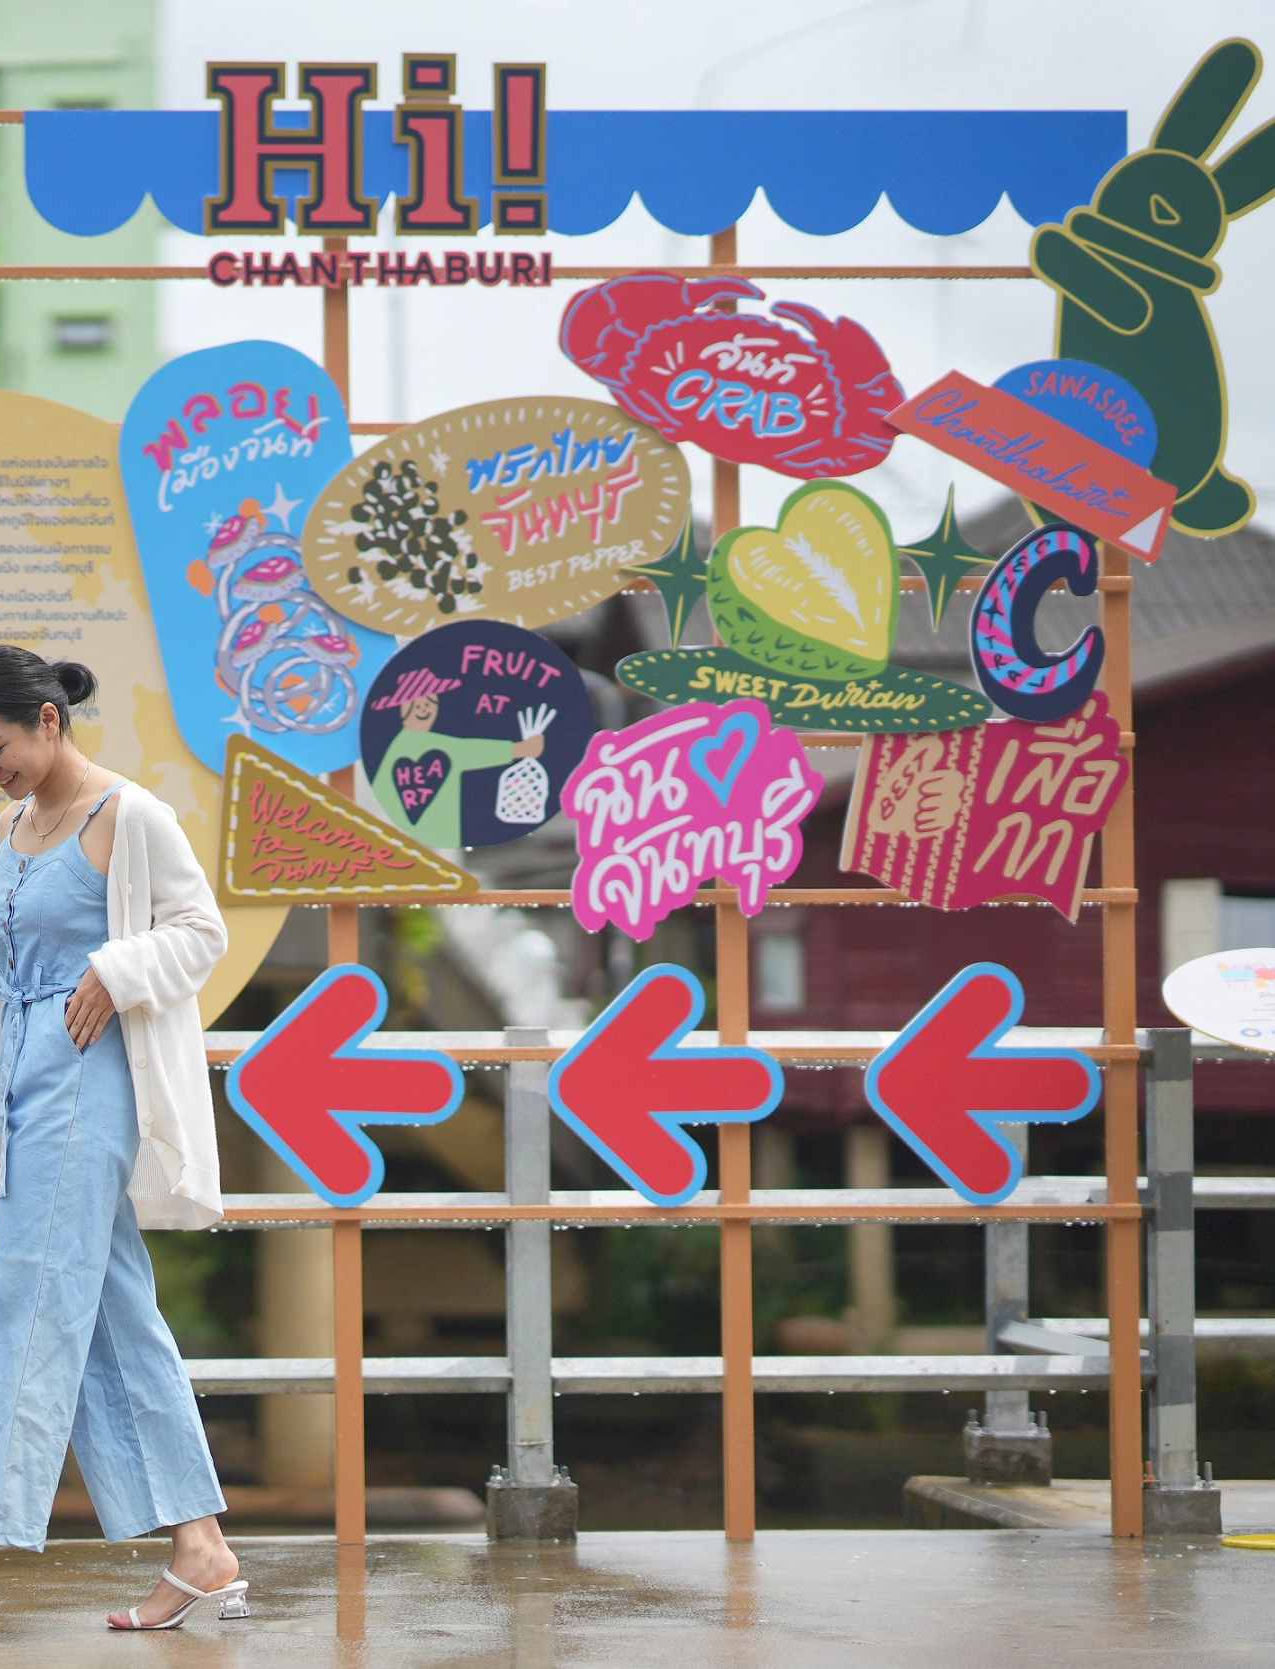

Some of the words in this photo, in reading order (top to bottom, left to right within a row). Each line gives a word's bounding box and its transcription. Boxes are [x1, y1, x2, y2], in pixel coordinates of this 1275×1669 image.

[204, 53, 546, 236] Hi!
[208, 250, 552, 287] CHANTHABURI
[700, 334, 817, 384] จันท์
[143, 382, 321, 471] พลอย
[666, 369, 807, 438] CRAB
[1025, 371, 1145, 445] SAWASDEE
[158, 417, 330, 512] เมืองจันท์
[465, 428, 637, 494] พริกไทย
[480, 453, 644, 556] จันทบุรี
[506, 559, 563, 592] BEST
[567, 538, 648, 579] PEPPER
[460, 645, 562, 689] FRUIT
[688, 666, 790, 702] SWEET
[784, 679, 925, 711] Durian
[475, 694, 511, 715] AT
[574, 716, 709, 848] ฉัน
[879, 751, 933, 822] BEST
[248, 780, 416, 871] Welcome
[250, 828, 306, 858] to
[589, 758, 813, 927] จันทบุรี
